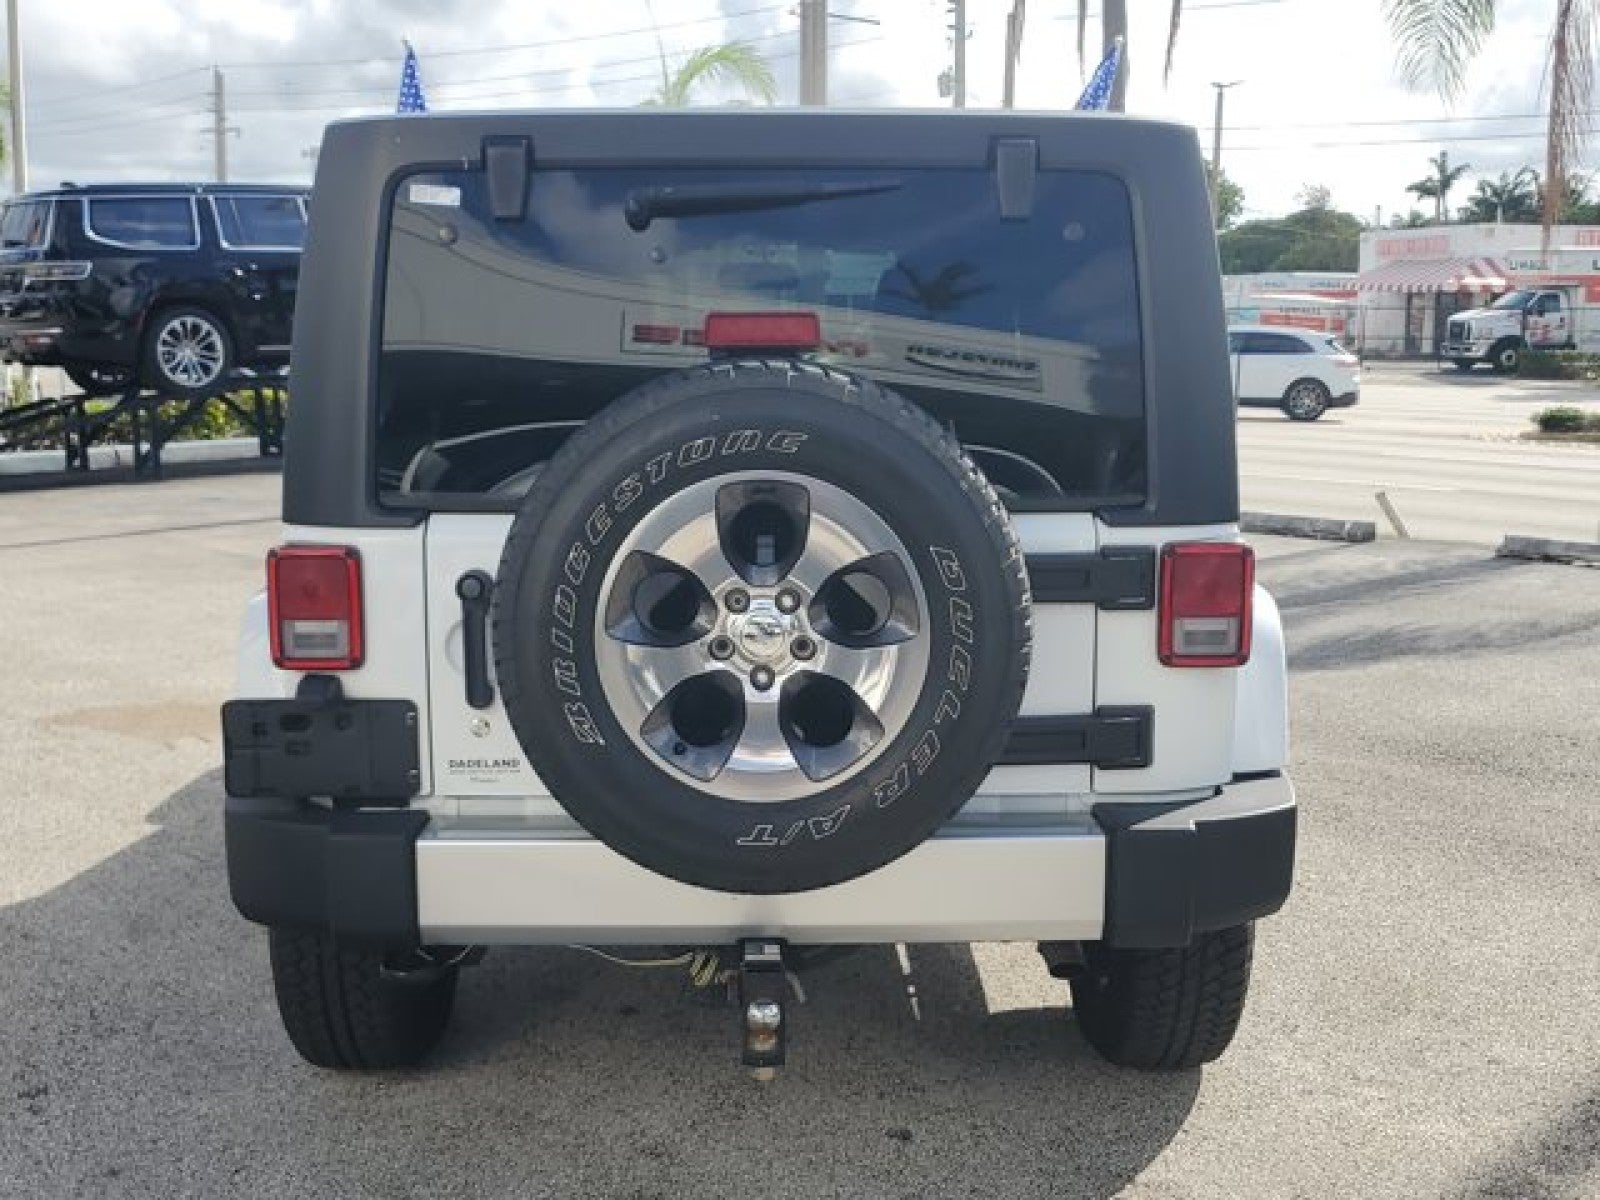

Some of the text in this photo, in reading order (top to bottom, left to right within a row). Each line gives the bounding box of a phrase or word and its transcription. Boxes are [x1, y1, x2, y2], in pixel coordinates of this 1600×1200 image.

[551, 429, 809, 747] BRIDGESTONE
[736, 545, 973, 847] DUELER A/T
